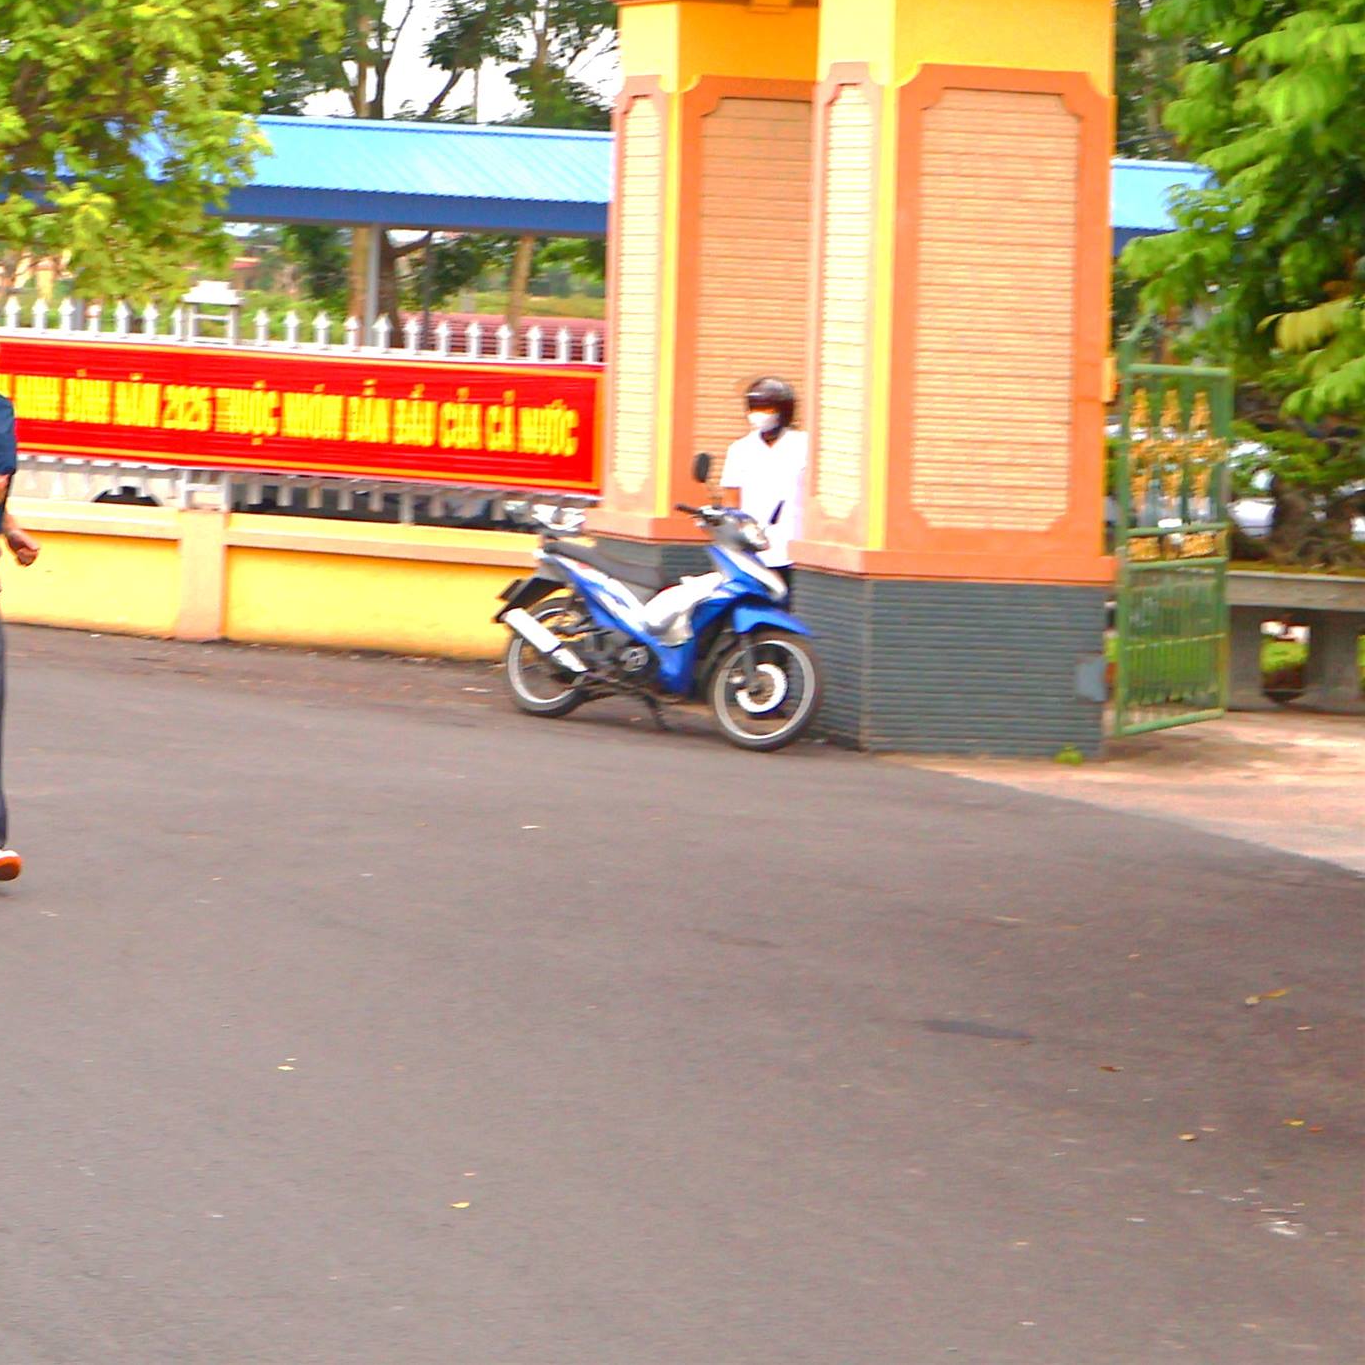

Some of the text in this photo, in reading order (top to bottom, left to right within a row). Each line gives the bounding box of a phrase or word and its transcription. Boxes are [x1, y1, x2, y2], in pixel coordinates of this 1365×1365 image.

[162, 384, 210, 432] 2025
[439, 387, 482, 449] CỦA
[485, 389, 515, 452] CẢ
[518, 398, 579, 456] NƯỚC
